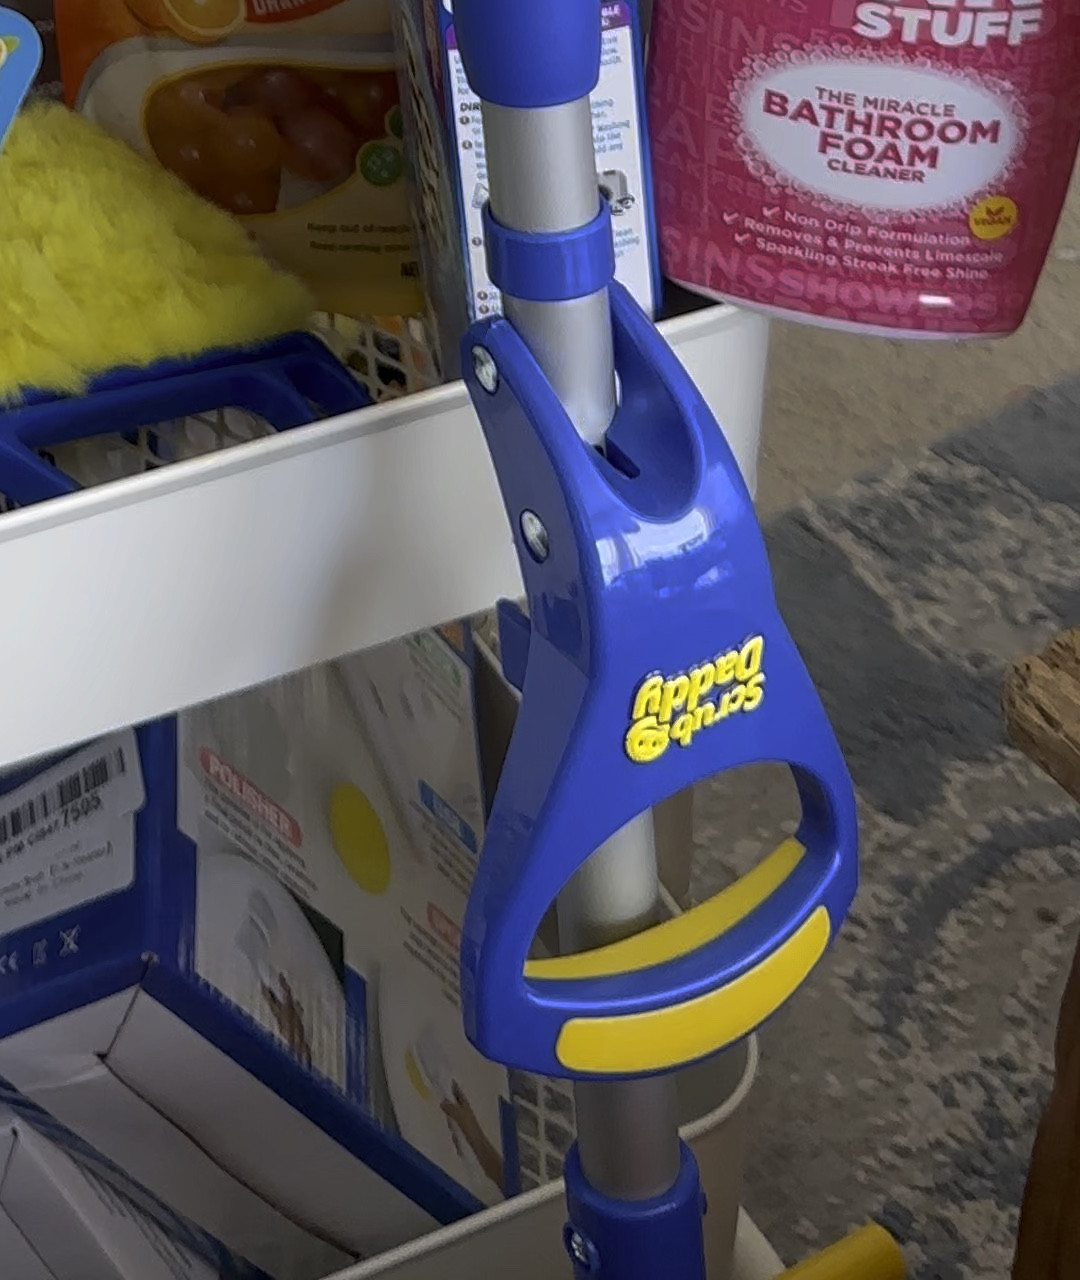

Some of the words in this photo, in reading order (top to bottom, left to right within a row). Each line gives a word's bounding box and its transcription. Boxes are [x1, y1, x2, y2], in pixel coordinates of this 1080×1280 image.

[851, 1, 1043, 48] STUFF
[761, 87, 1002, 146] BATHROOM
[815, 86, 856, 107] THE
[862, 94, 957, 119] MIRACLE
[817, 129, 940, 169] FOAM
[826, 157, 927, 184] CLEANER
[743, 217, 822, 245] Removes
[827, 235, 838, 249] &
[843, 238, 921, 261] Prevents
[924, 248, 1004, 266] Limescale
[783, 209, 820, 230] Non
[824, 218, 862, 237] Drip
[867, 225, 970, 246] Formulation
[755, 236, 837, 267] Sparkling
[841, 254, 897, 275] Streak
[903, 263, 941, 279] Free
[631, 634, 765, 724] Daddy
[669, 671, 767, 748] Scrub
[208, 751, 294, 834] POLISHER
